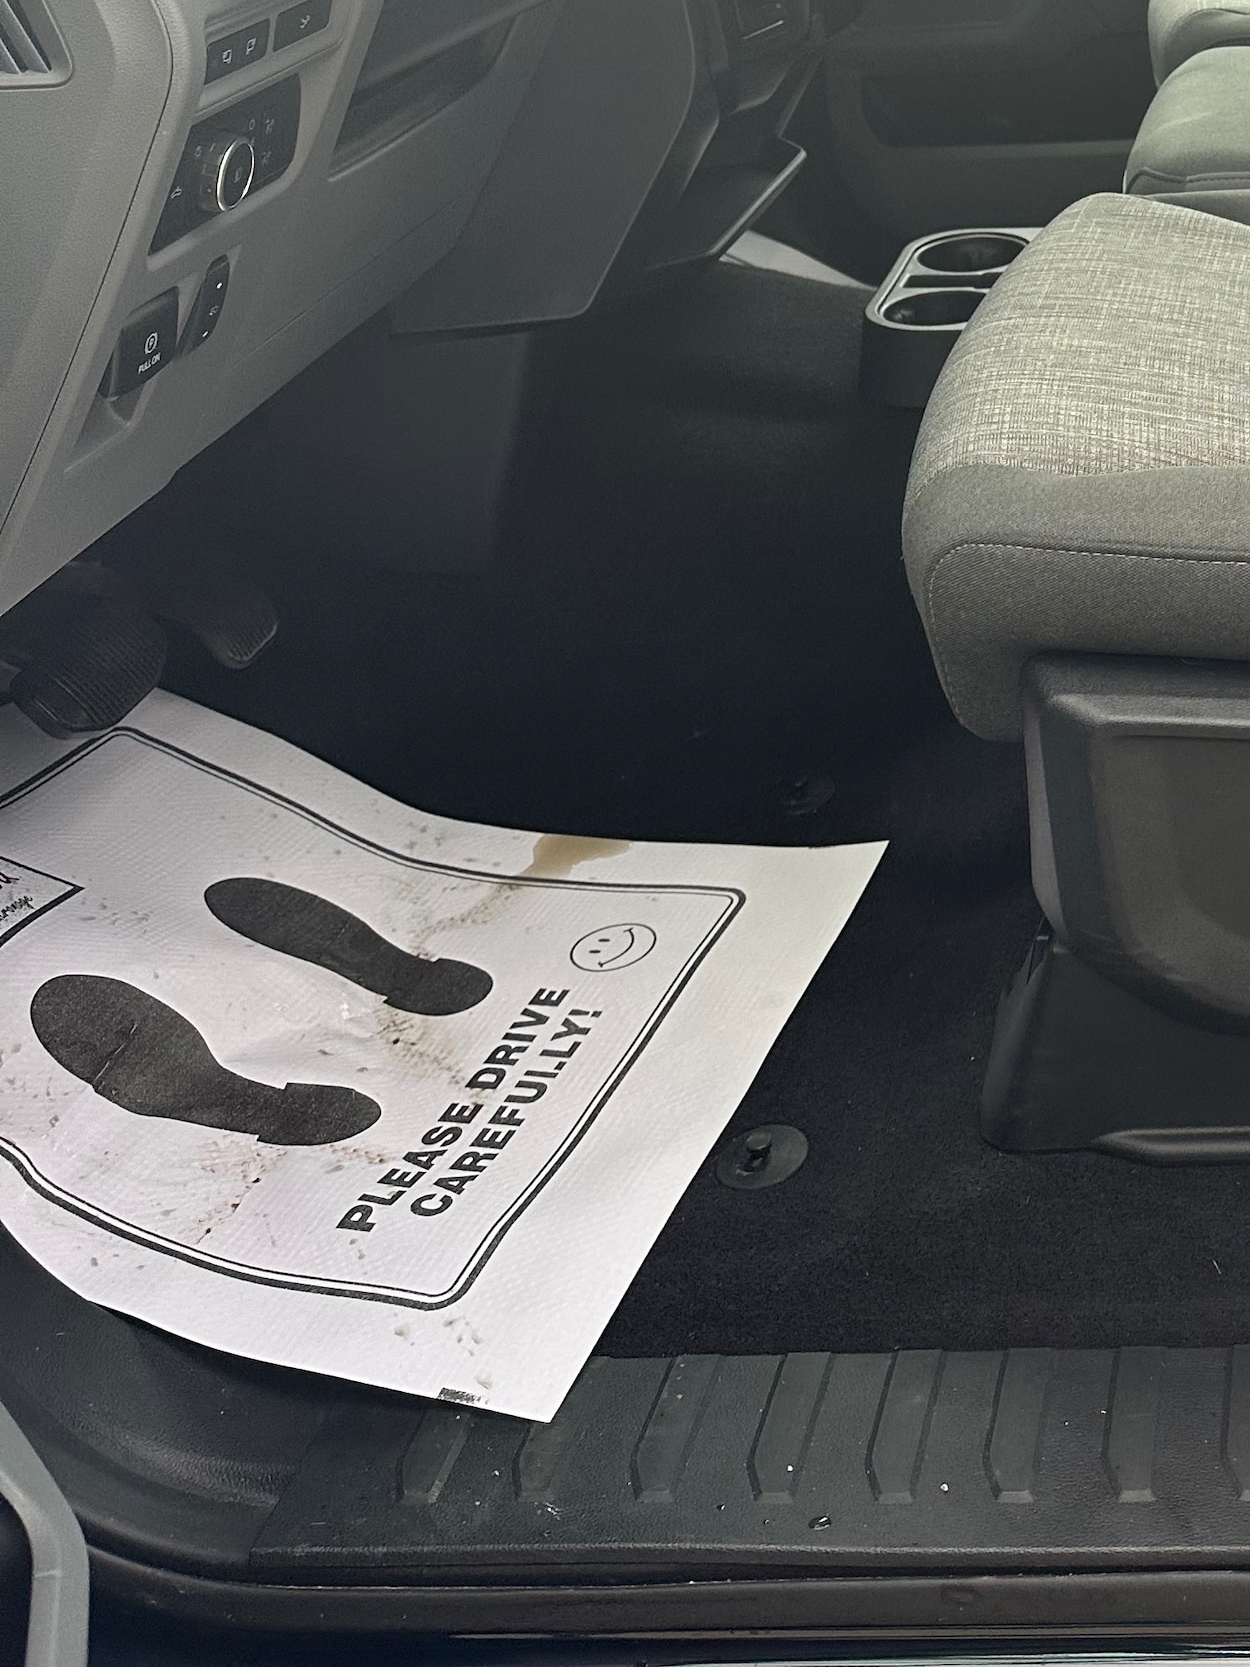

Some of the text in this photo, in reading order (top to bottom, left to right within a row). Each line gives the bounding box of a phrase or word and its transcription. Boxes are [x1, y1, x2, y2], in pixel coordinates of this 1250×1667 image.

[336, 988, 570, 1232] PLEASE DRIVE
[410, 1009, 603, 1217] CAREFULLY!
